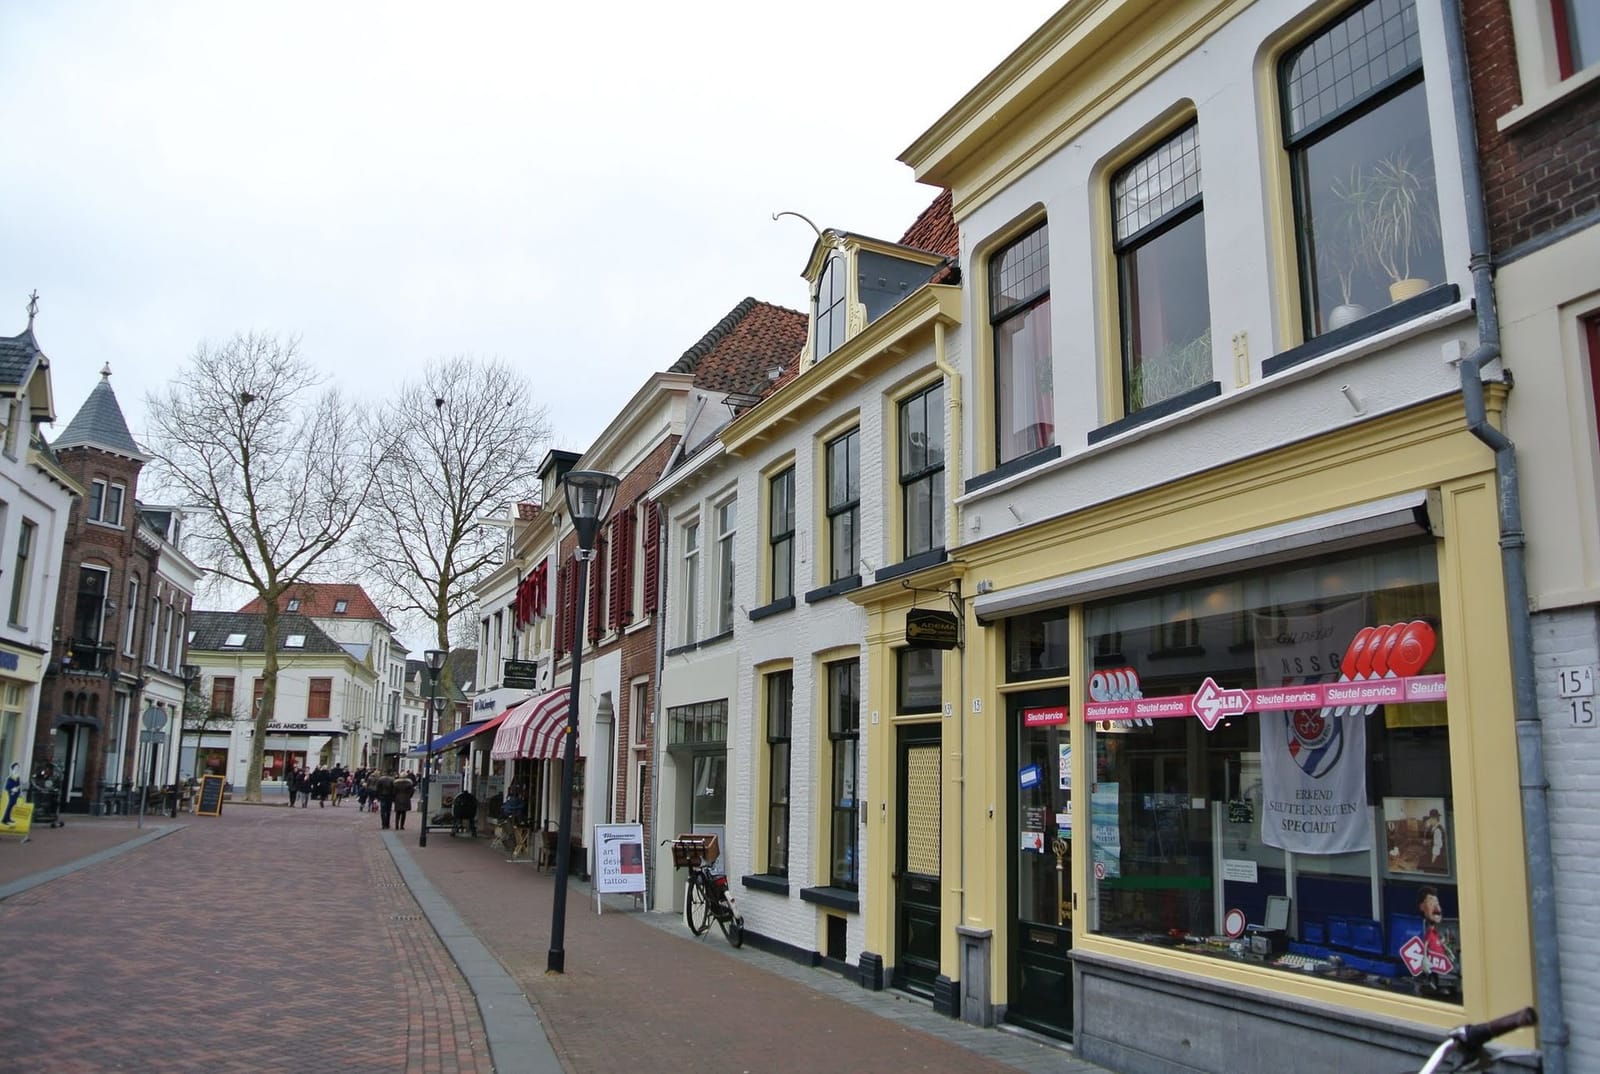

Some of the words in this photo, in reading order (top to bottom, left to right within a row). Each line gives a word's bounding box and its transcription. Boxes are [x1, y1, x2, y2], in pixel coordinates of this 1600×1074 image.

[1256, 693, 1285, 704] Sleutel
[1285, 691, 1316, 703] service
[1328, 688, 1360, 700] Sleutel
[1361, 685, 1397, 697] service
[1137, 702, 1159, 713] Sleutel
[1159, 701, 1184, 712] service
[1197, 685, 1243, 721] SILCA
[1027, 713, 1045, 721] Sleutel
[1045, 711, 1063, 720] service
[1087, 706, 1107, 716] Sleutel
[1107, 705, 1129, 715] service
[1571, 701, 1592, 723] 15
[1296, 789, 1333, 800] ERKEND
[604, 877, 628, 885] tattoo
